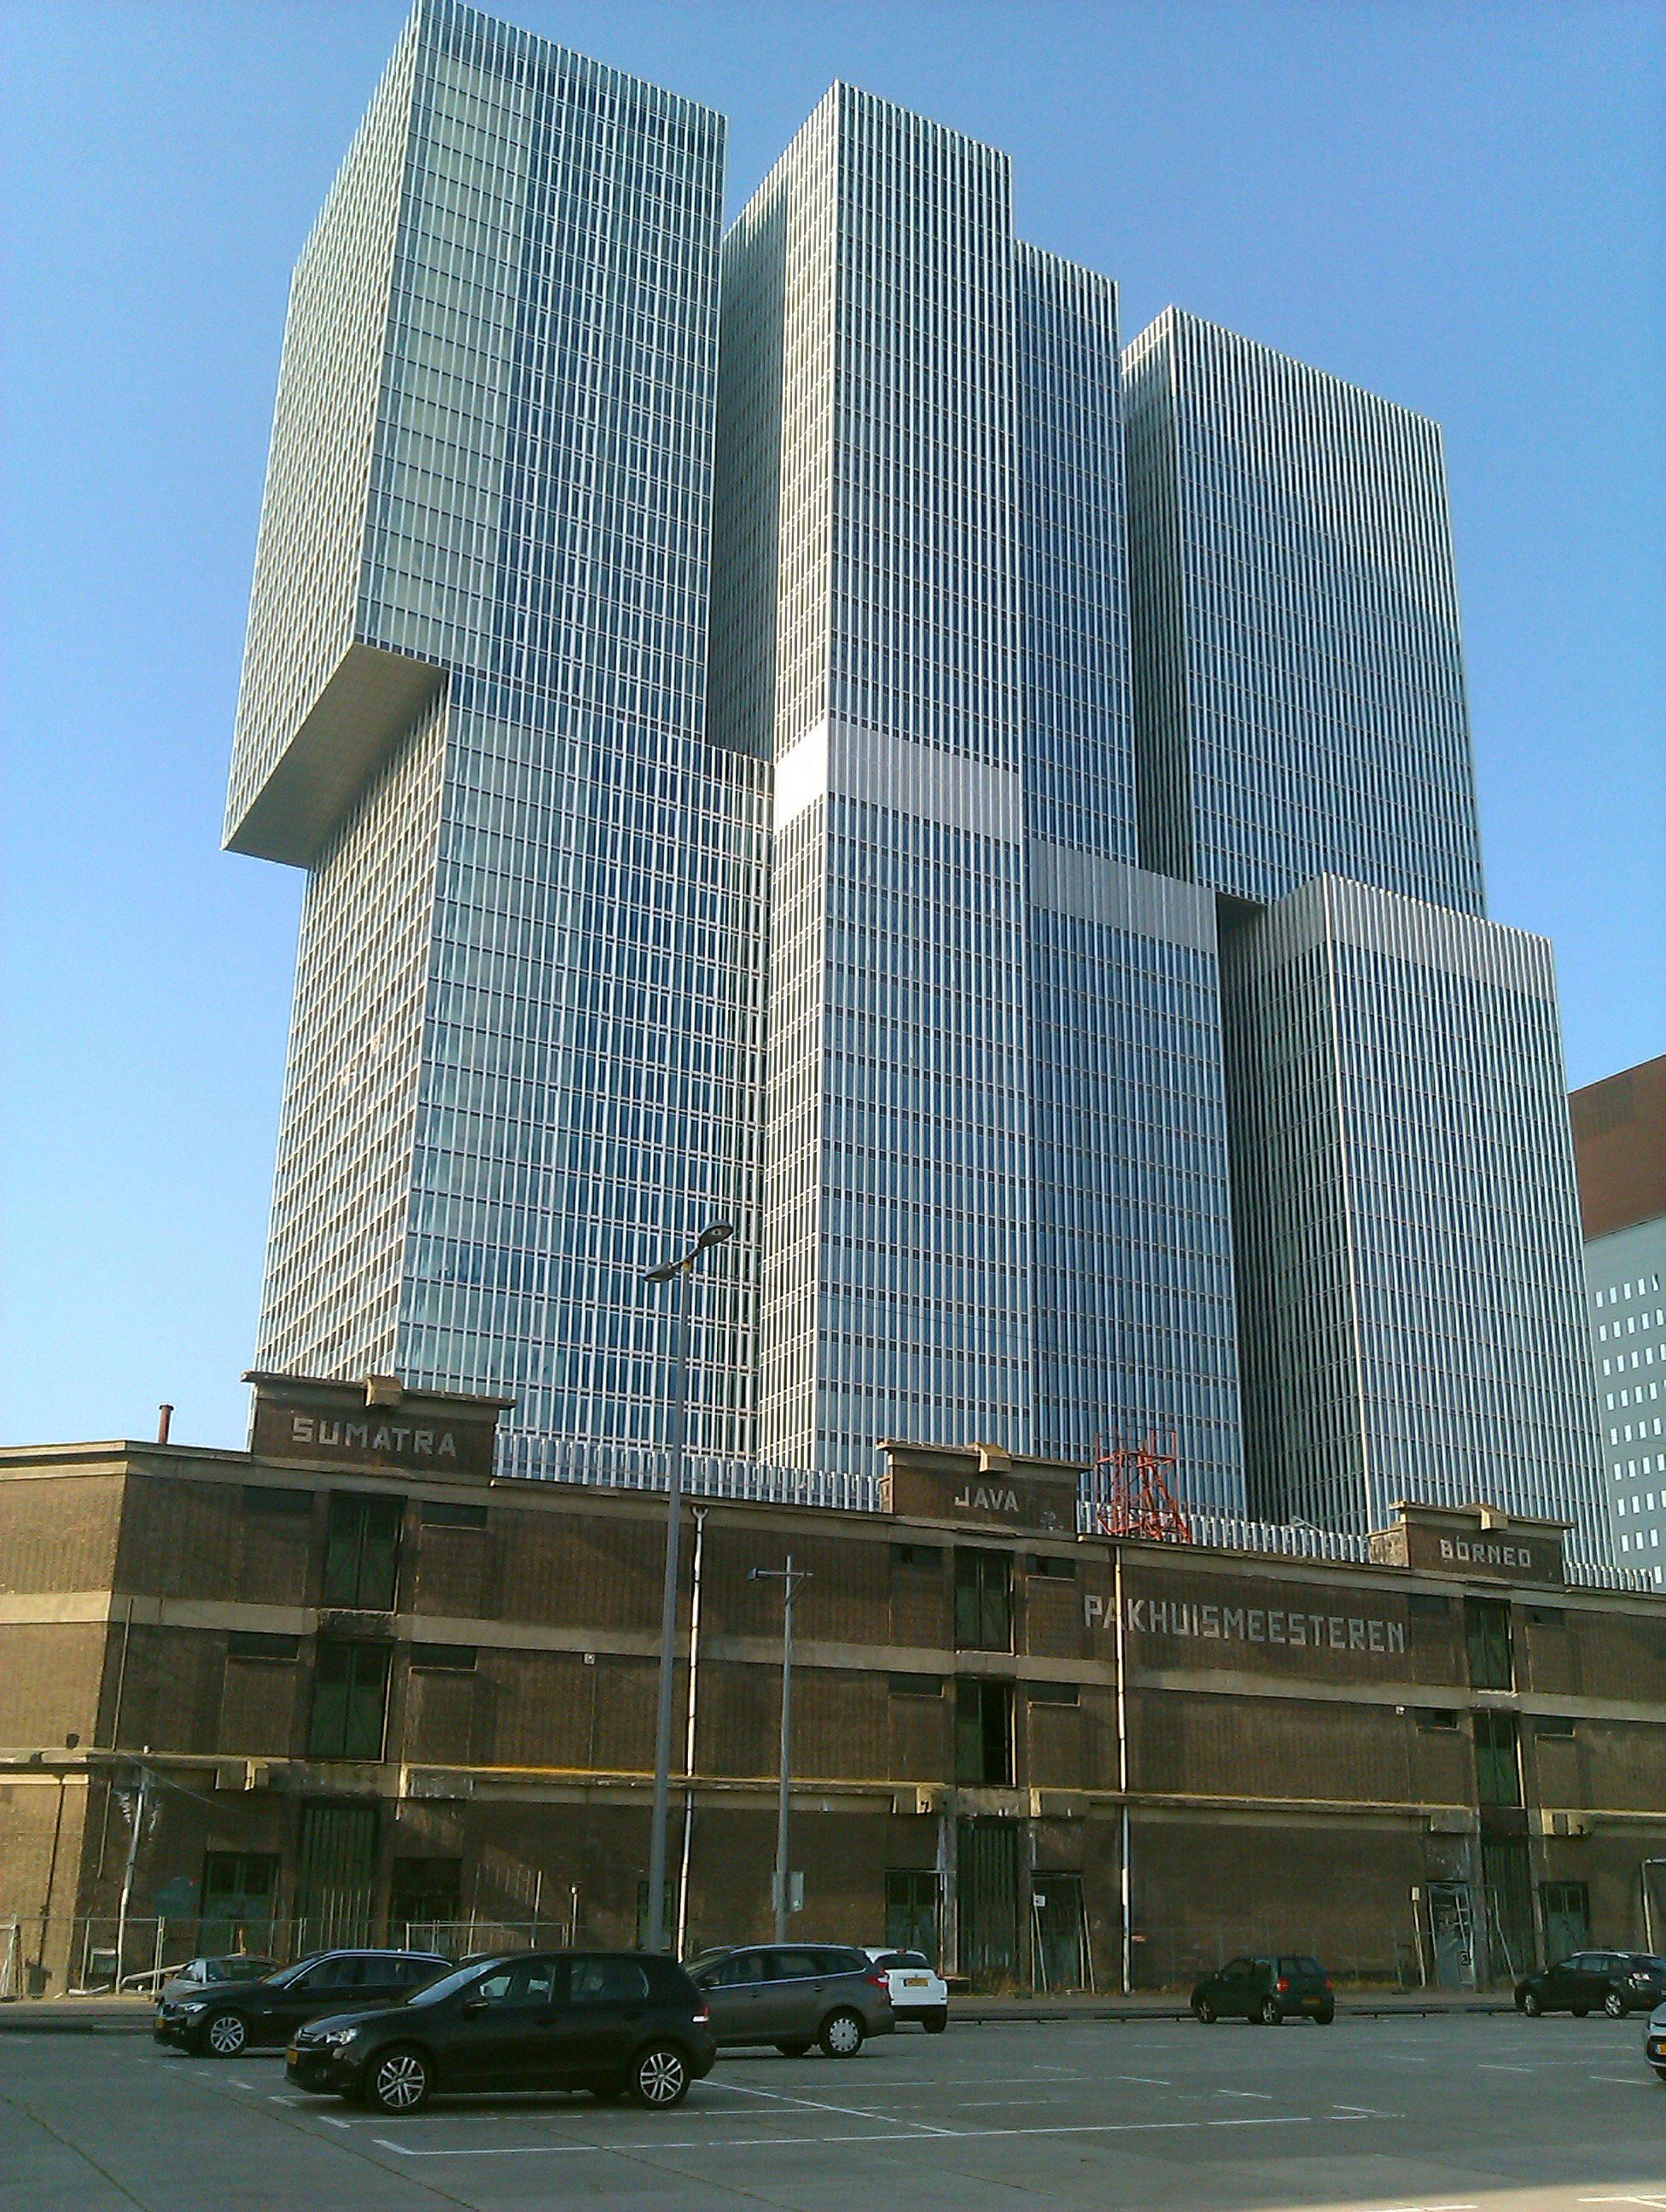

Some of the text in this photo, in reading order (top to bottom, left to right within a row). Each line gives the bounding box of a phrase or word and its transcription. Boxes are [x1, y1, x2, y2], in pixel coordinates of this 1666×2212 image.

[292, 1417, 457, 1457] SUMATRA
[954, 1486, 1019, 1512] JAVA
[1440, 1539, 1532, 1569] BORNEO
